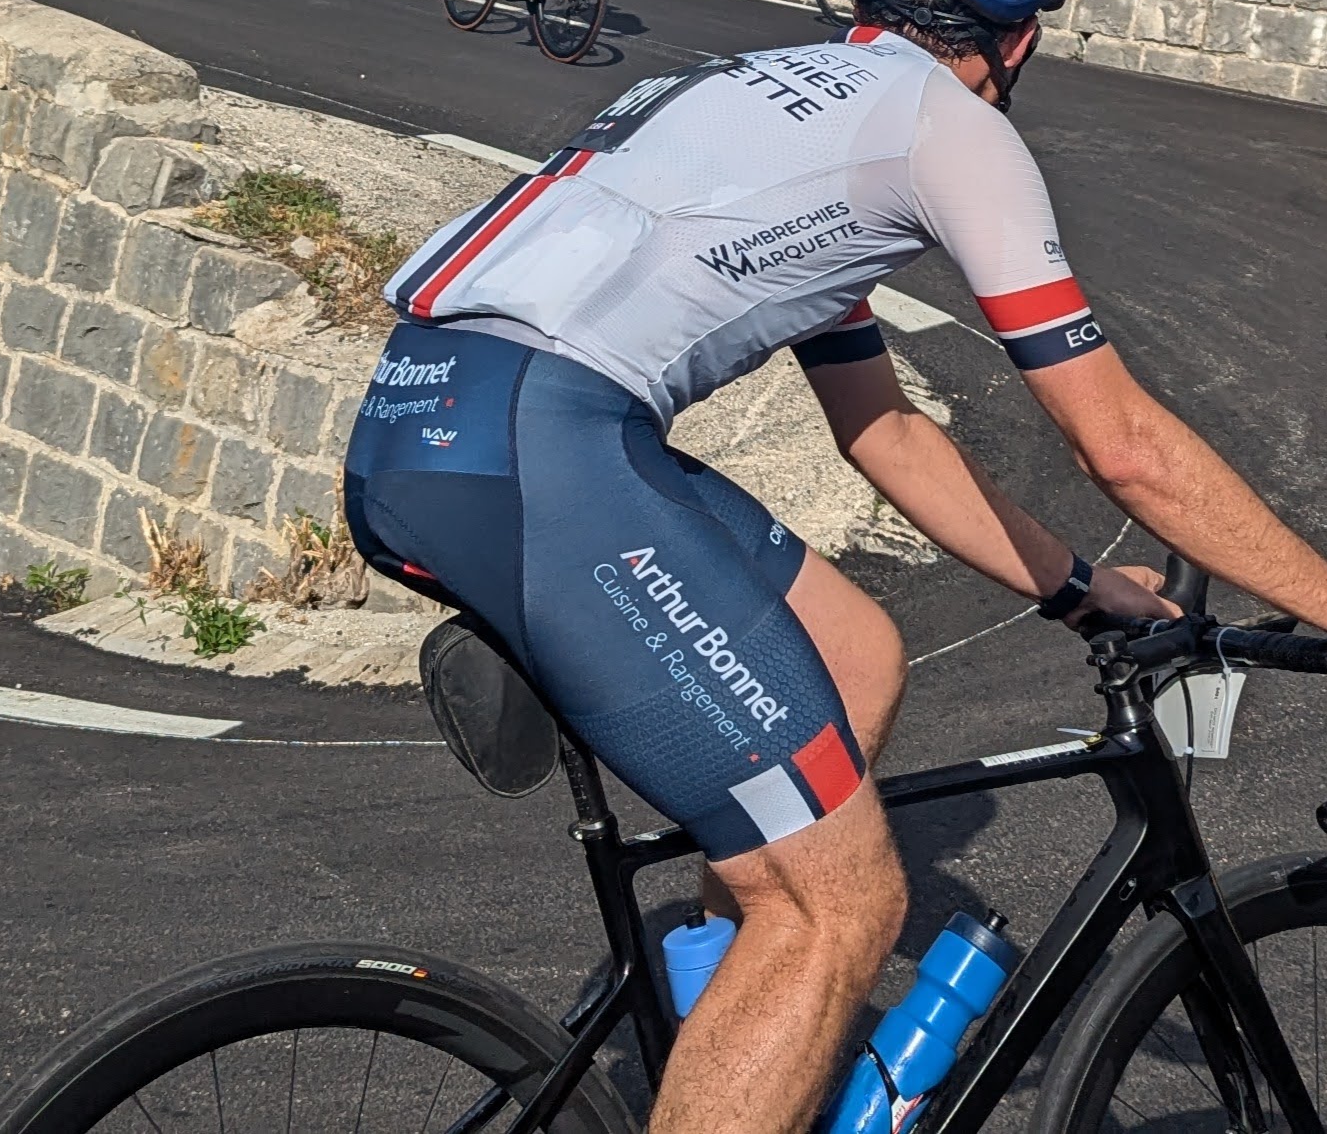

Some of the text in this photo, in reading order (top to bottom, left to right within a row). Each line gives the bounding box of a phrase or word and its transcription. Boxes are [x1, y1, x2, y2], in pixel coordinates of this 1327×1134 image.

[694, 201, 850, 276] WAMBRECHIES
[726, 220, 863, 282] MARQUETTE
[593, 563, 752, 751] Cuisine & Rangement
[619, 546, 789, 733] Arthur Bonnet
